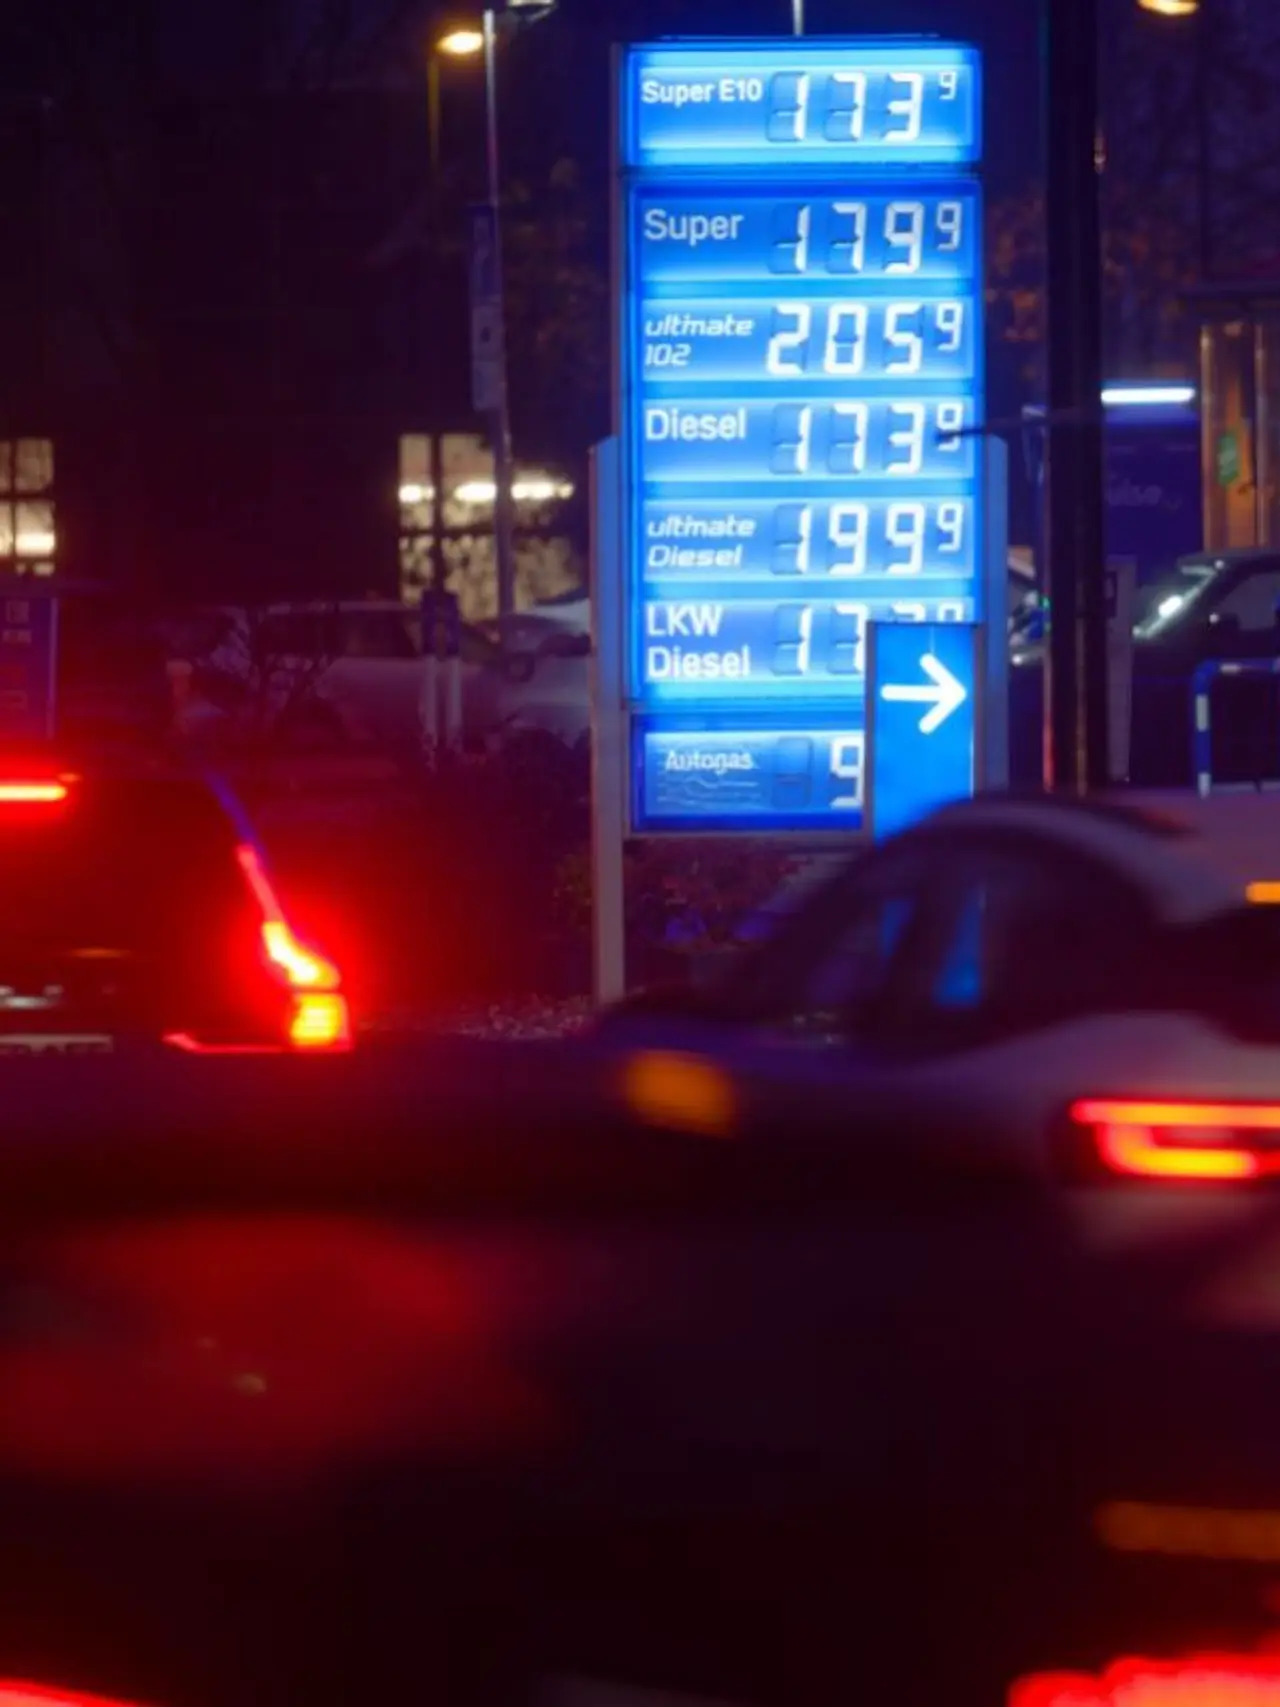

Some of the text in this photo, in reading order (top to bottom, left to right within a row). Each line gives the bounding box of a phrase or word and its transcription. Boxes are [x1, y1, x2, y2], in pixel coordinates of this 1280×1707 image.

[641, 79, 763, 108] Super E10
[643, 208, 744, 247] Super
[644, 313, 755, 338] ultimate
[645, 344, 691, 367] 102
[645, 407, 747, 443] Diesel
[647, 514, 756, 538] ultimate
[647, 544, 744, 568] Diesel
[646, 604, 724, 637] LKW
[646, 645, 751, 679] Diesel
[665, 749, 755, 777] Autogas
